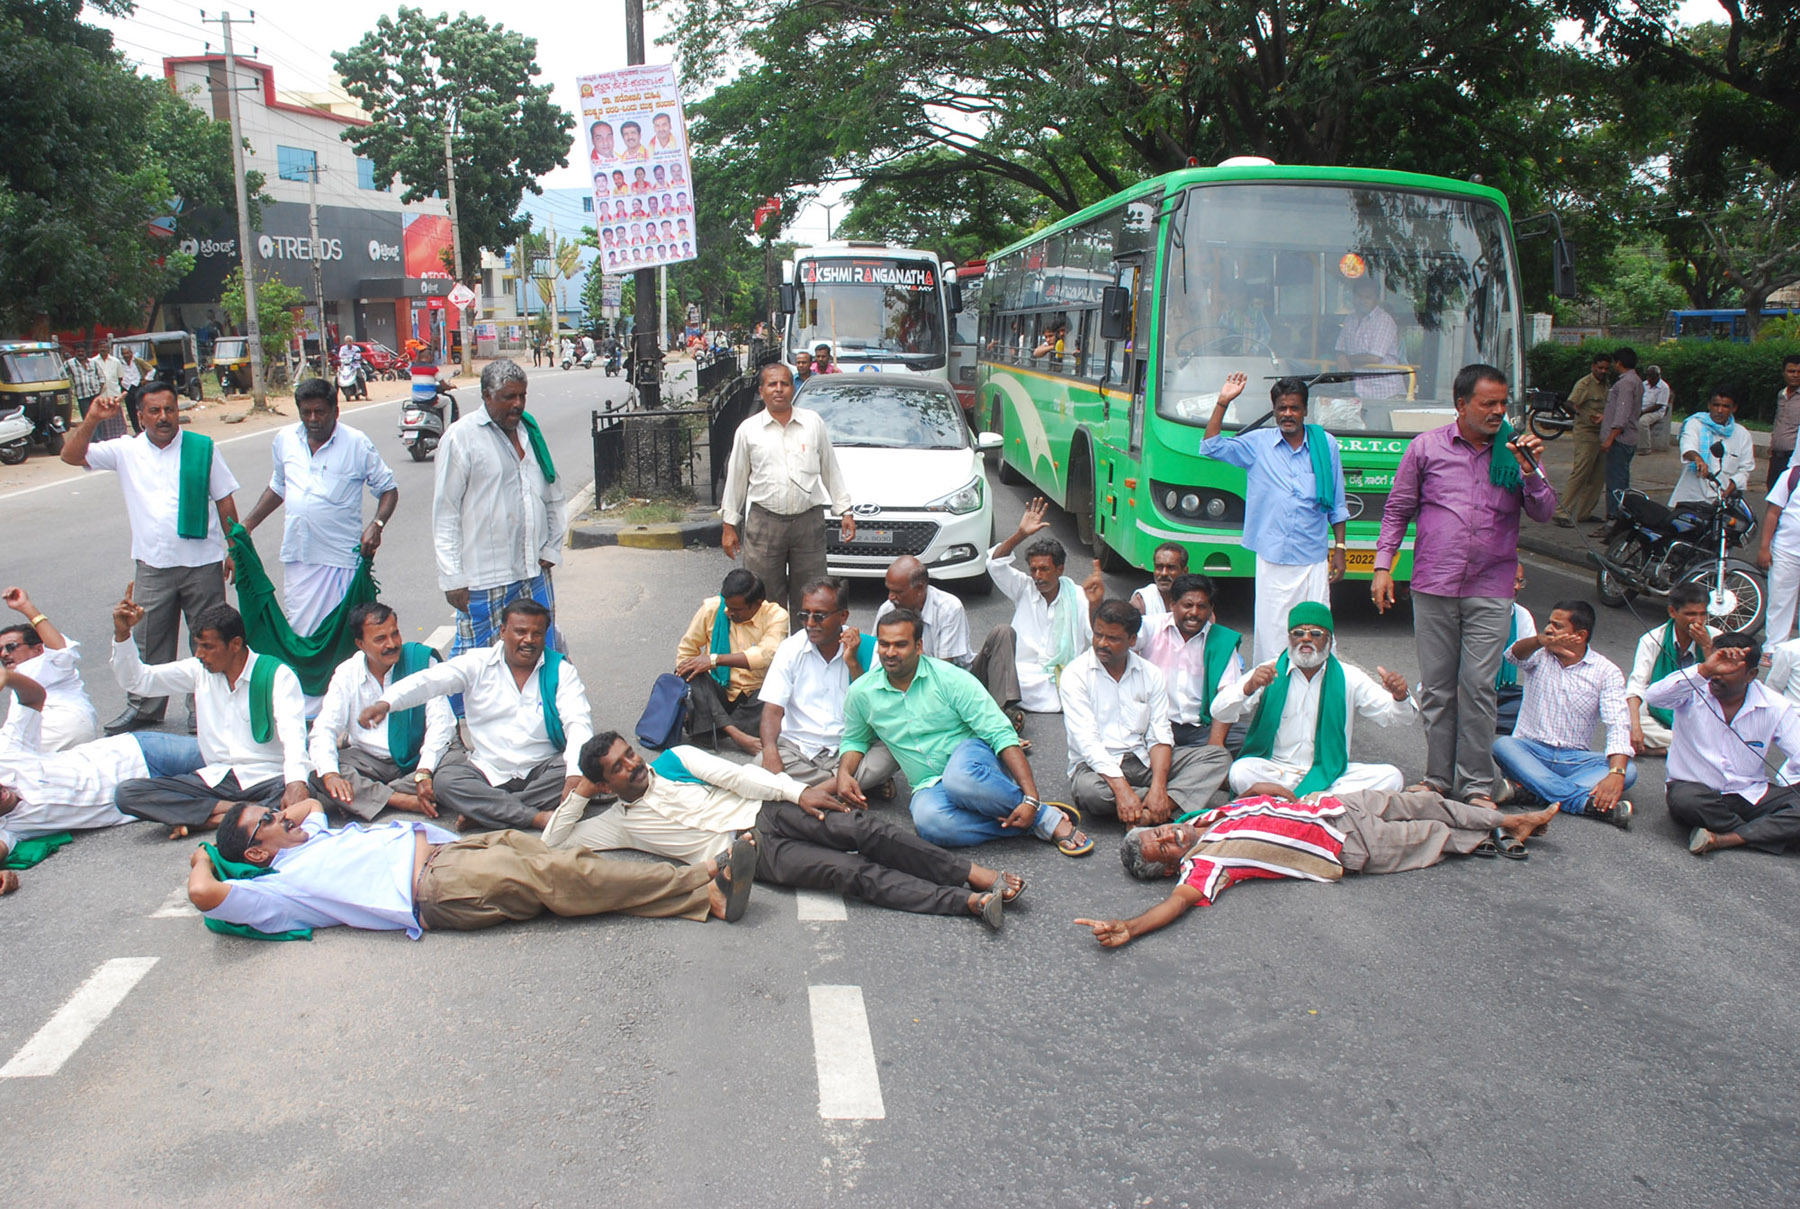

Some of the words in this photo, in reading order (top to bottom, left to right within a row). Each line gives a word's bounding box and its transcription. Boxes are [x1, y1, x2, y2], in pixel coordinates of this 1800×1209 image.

[801, 267, 852, 282] LAKSHMI
[854, 267, 934, 285] RANGANATHA
[894, 284, 934, 292] SWAMY
